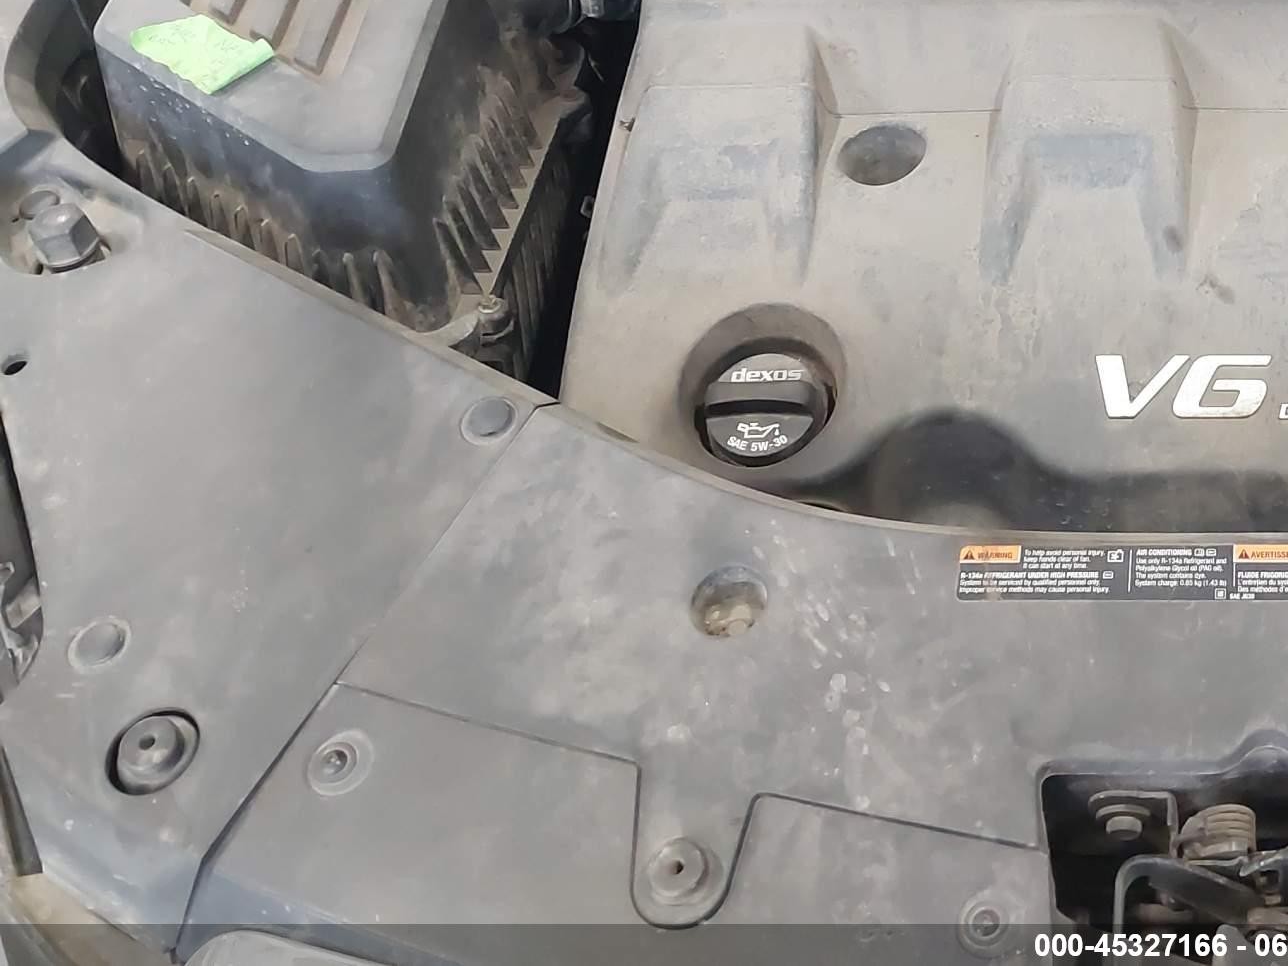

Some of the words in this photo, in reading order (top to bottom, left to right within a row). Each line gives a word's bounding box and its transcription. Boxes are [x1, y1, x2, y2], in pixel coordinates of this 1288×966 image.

[731, 368, 804, 383] dexos
[1095, 354, 1272, 419] V6
[727, 436, 750, 451] SAE
[750, 434, 788, 452] 5W-30
[1032, 549, 1045, 557] help
[1062, 549, 1088, 557] personal
[1136, 572, 1147, 580] The
[1147, 572, 1169, 580] system
[1023, 579, 1032, 587] by
[1008, 587, 1034, 595] methods
[1034, 587, 1048, 595] may
[1048, 587, 1066, 595] cause
[1066, 587, 1092, 595] personal
[1237, 586, 1250, 594] Des
